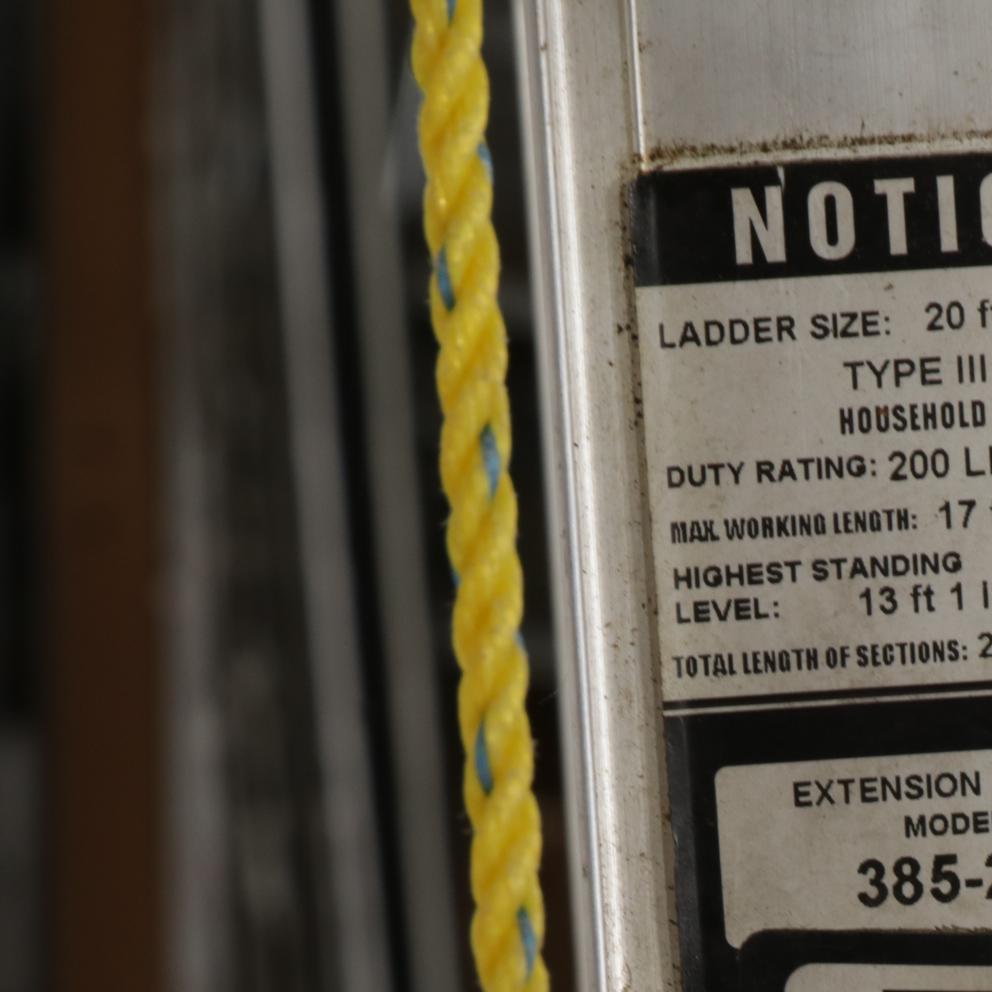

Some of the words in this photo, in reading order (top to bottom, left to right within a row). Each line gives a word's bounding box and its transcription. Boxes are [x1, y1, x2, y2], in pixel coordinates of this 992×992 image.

[659, 315, 796, 349] LADDER
[810, 311, 891, 339] SIZE:
[925, 303, 965, 331] 20
[843, 358, 943, 390] TYPE
[957, 355, 987, 384] III
[839, 400, 986, 432] HOUSEHOLD
[666, 462, 744, 489] DUTY
[756, 456, 878, 484] RATING:
[888, 450, 950, 481] 200
[725, 514, 826, 541] WORKING
[834, 509, 918, 535] LENGTH:
[938, 500, 977, 530] 17
[674, 562, 801, 590] HIGHEST
[812, 552, 963, 581] STANDING
[676, 600, 780, 623] LEVEL:
[860, 587, 898, 615] 13
[912, 584, 935, 613] ft
[951, 582, 964, 609] 1
[673, 654, 737, 678] TOTAL
[743, 647, 819, 675] LENGTH
[826, 647, 852, 669] OF
[857, 641, 968, 668] SECTIONS:
[793, 771, 981, 808] EXTENSION
